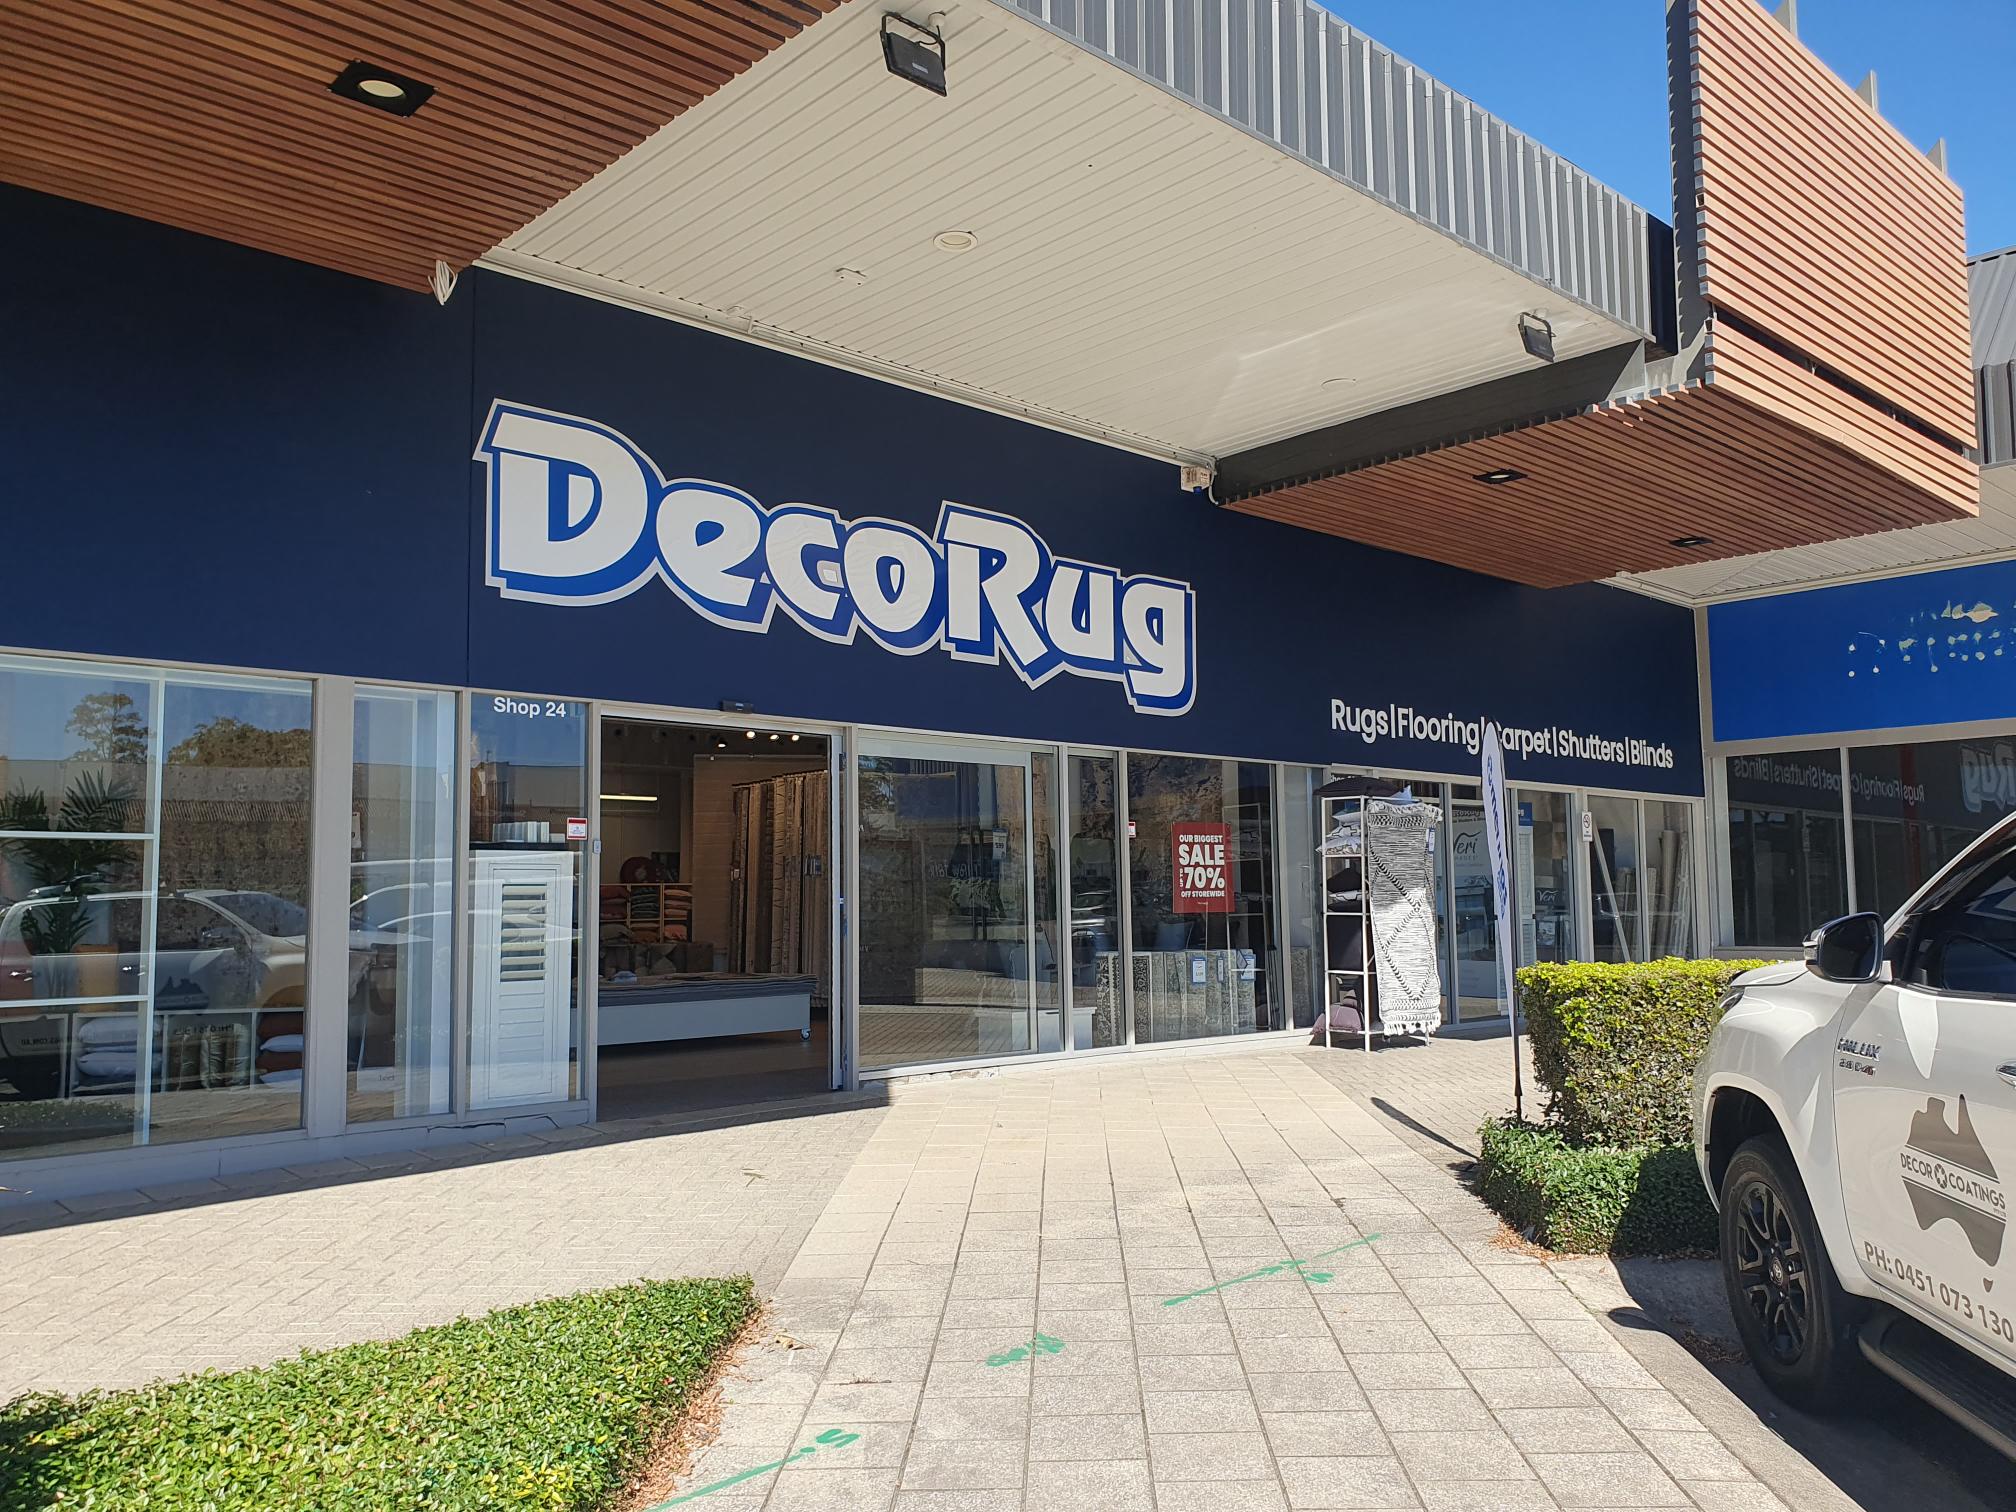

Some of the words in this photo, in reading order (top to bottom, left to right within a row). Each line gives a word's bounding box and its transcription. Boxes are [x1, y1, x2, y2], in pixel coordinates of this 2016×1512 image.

[493, 697, 541, 718] Shop
[545, 702, 567, 718] 24
[1179, 834, 1194, 843] OUR
[1194, 835, 1223, 843] BIGGEST
[1178, 844, 1225, 866] SALE
[1184, 866, 1226, 889] 70%
[1181, 890, 1191, 898] OFF
[1192, 890, 1225, 898] STOREWIDE
[1900, 1152, 1934, 1180] DECOR
[1948, 1172, 2006, 1210] COATINGS
[1894, 1258, 1936, 1298] 0451
[1939, 1282, 1974, 1320] 073
[1977, 1304, 2014, 1343] 130
